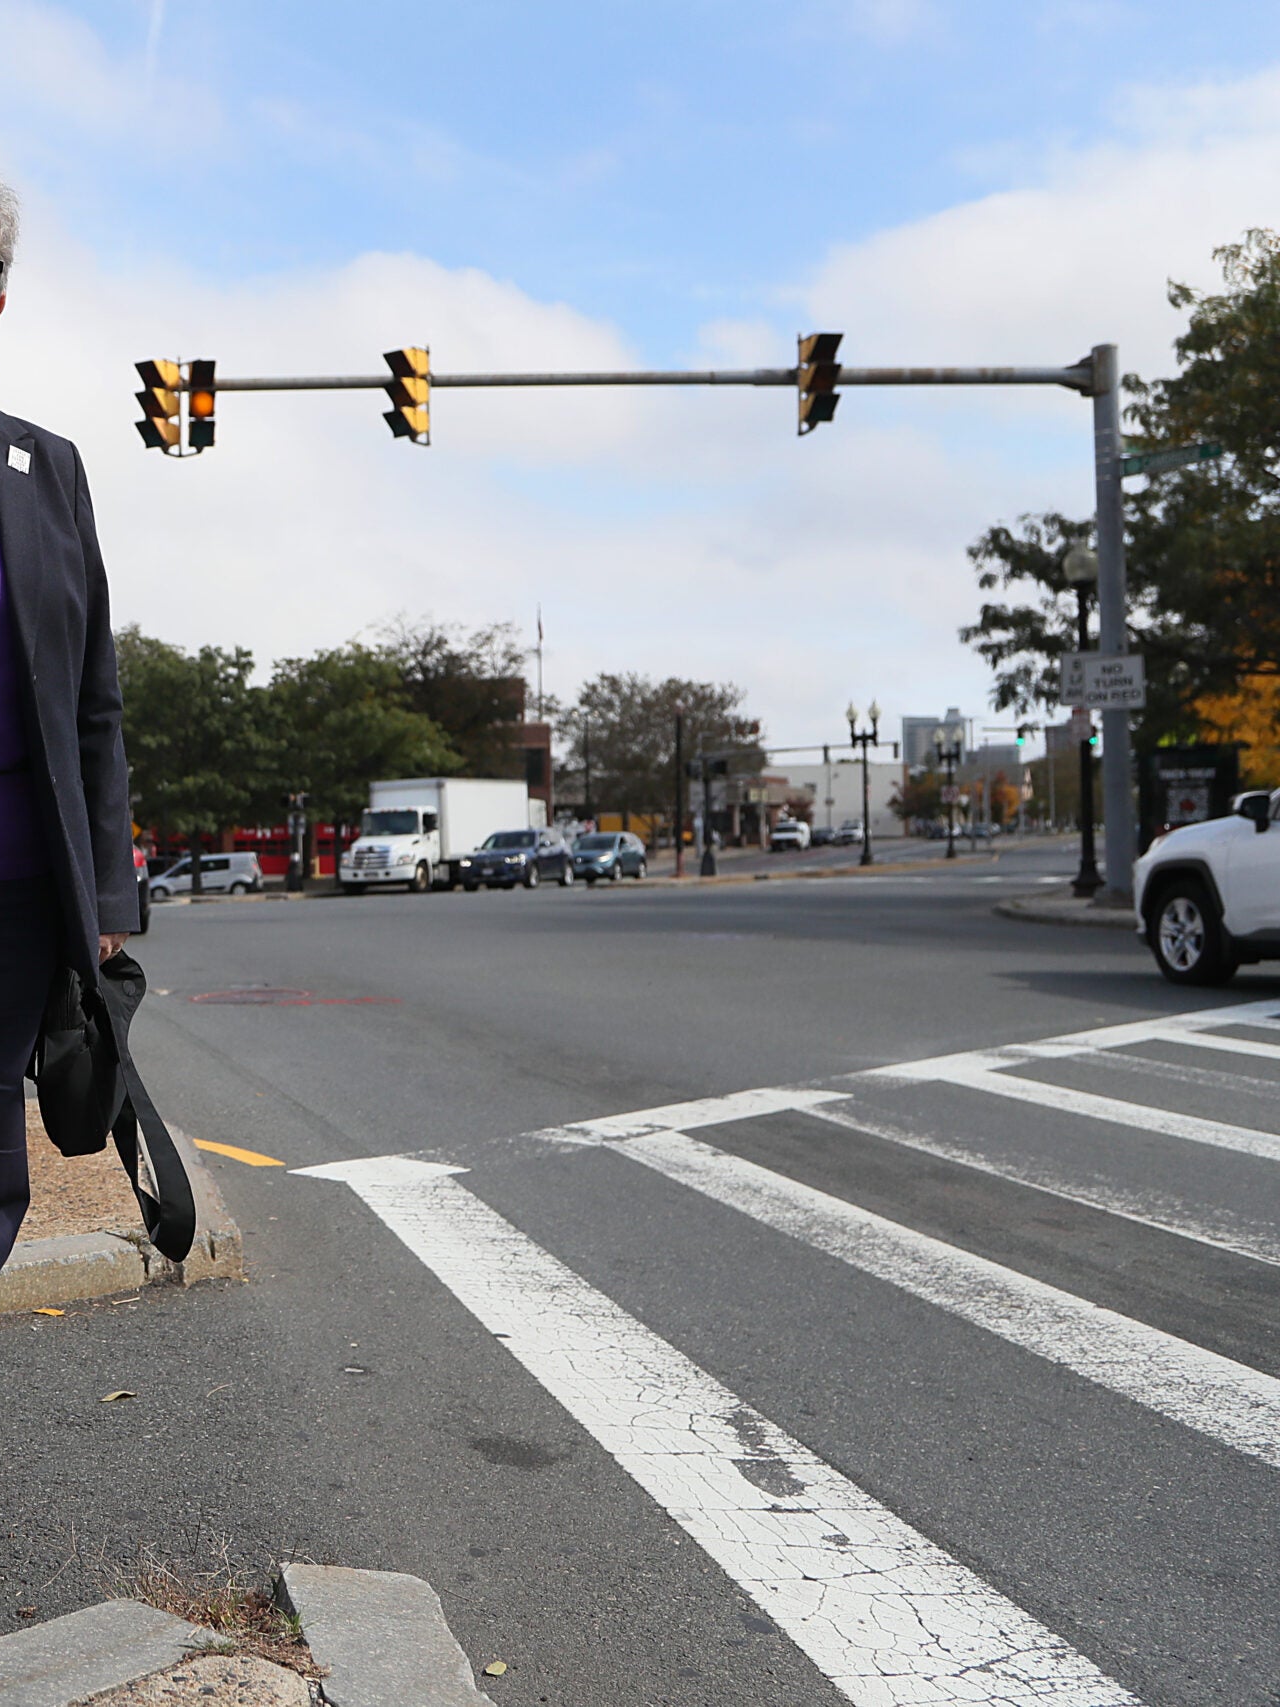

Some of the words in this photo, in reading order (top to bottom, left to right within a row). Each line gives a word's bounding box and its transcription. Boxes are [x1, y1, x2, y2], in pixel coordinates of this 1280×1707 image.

[1102, 663, 1123, 674] NO
[1094, 676, 1133, 687] TURN
[1086, 692, 1108, 702] ON
[1110, 689, 1141, 700] RED
